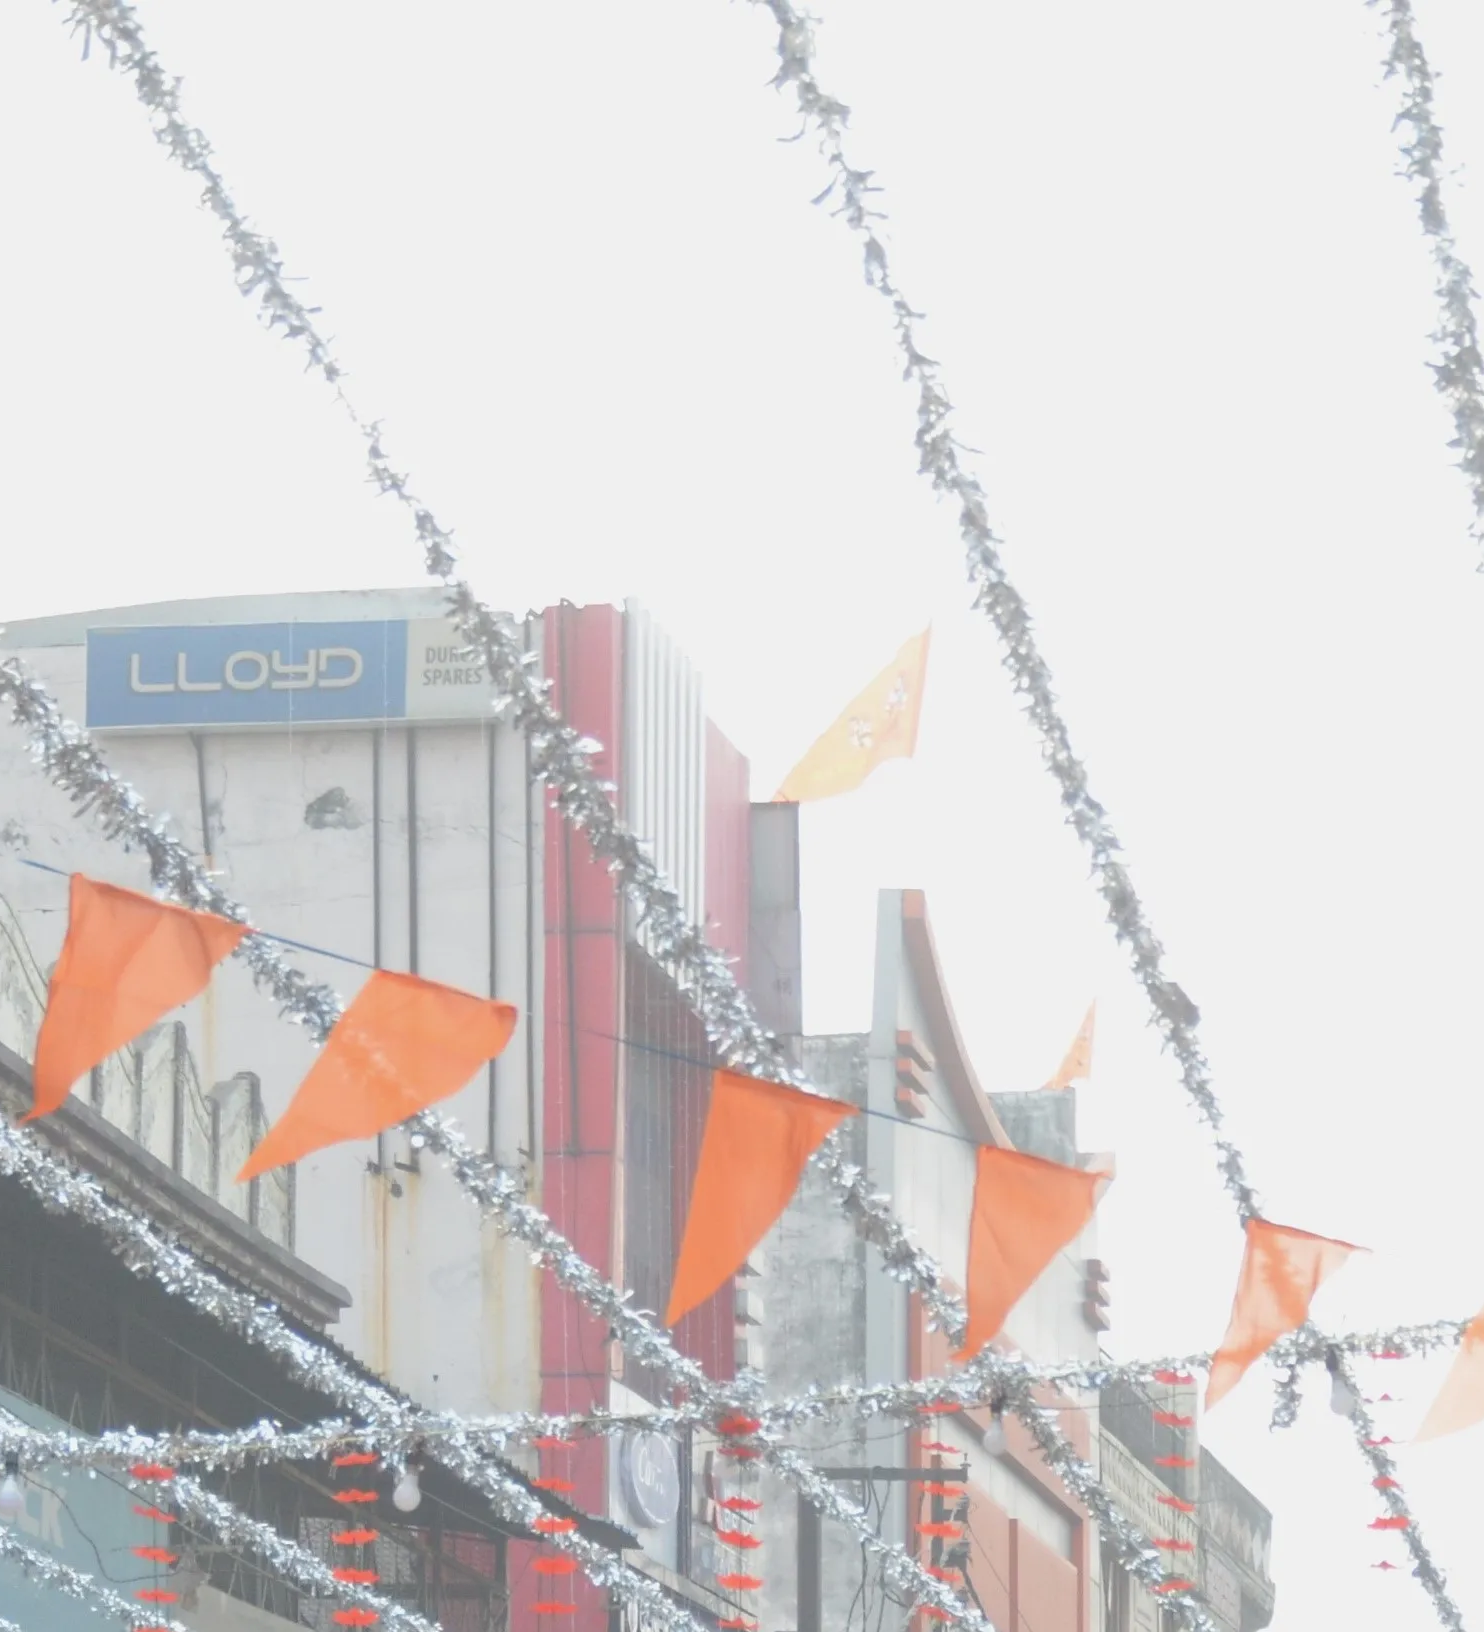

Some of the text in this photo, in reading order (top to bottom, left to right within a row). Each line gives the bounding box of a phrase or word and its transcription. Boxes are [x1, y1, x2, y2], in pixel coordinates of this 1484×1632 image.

[425, 645, 481, 665] DUR
[130, 646, 363, 695] LLOYD
[422, 666, 483, 687] SPARES
